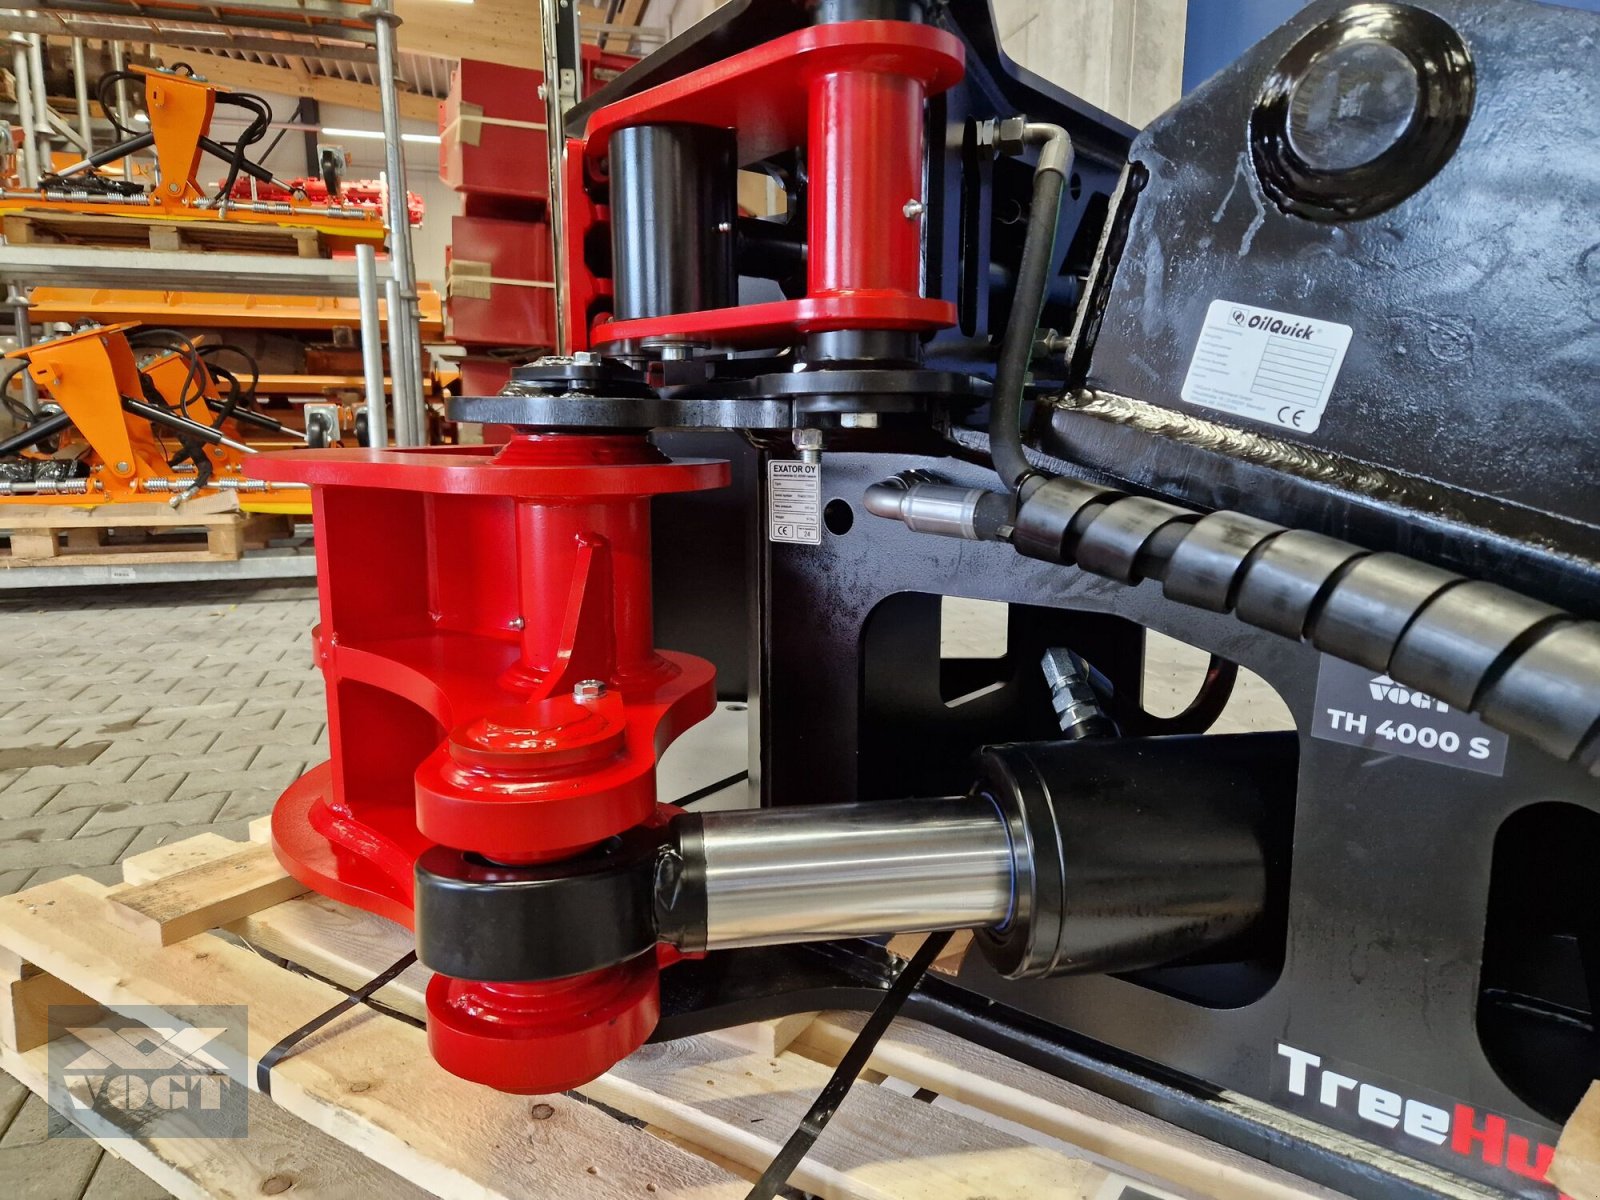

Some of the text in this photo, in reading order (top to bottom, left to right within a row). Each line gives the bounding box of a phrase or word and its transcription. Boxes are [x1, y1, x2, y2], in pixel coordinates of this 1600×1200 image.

[1248, 315, 1314, 340] OilQuick
[773, 464, 816, 474] EXATOR OY
[1327, 708, 1491, 760] TH 4000 S
[1277, 1043, 1557, 1186] TreeHu
